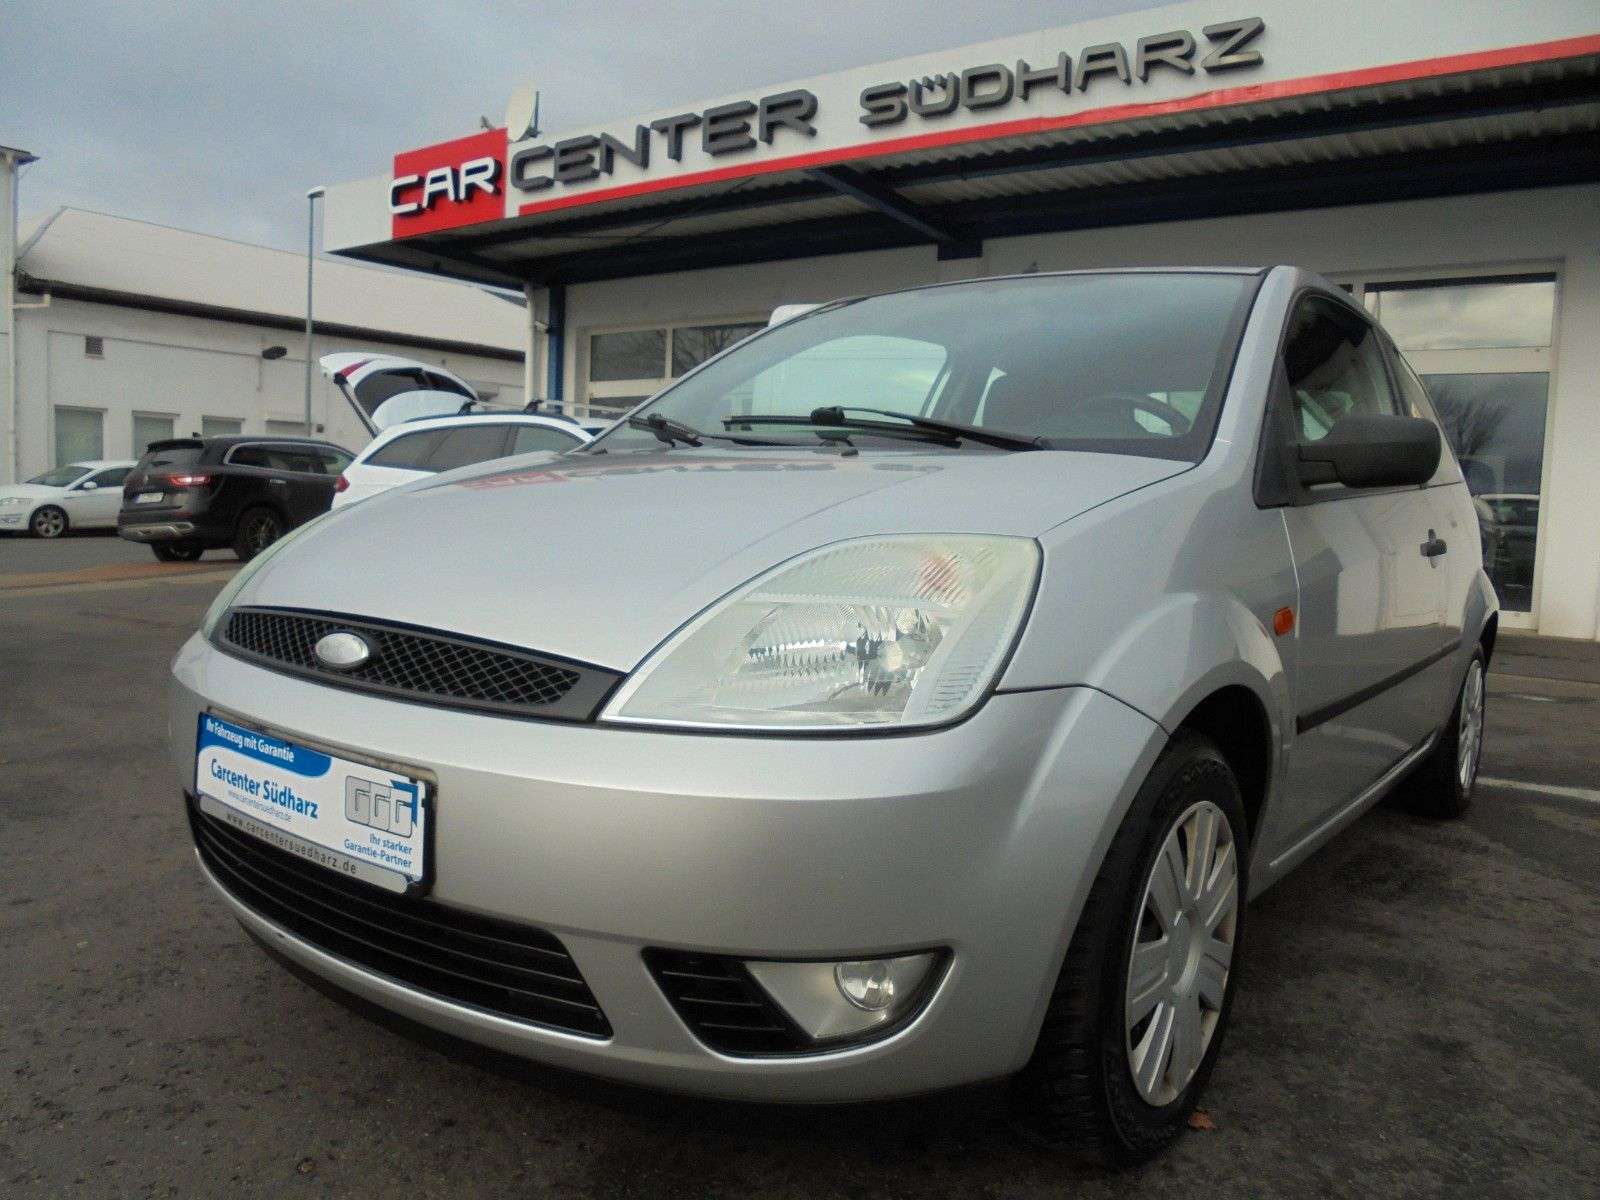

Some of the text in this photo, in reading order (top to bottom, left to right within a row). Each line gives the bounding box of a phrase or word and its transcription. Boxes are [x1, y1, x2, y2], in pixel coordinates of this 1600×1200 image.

[389, 16, 1265, 214] CAR CENTER SÜDHARZ
[214, 722, 243, 748] Fahrzeug
[244, 736, 257, 750] mit
[257, 739, 294, 762] Garantie
[211, 758, 318, 819] Carcenter Südharz
[226, 813, 358, 874] www.carcentersuedharz.de
[344, 838, 412, 868] Garantie-Partner
[369, 833, 412, 855] Ihr starker
